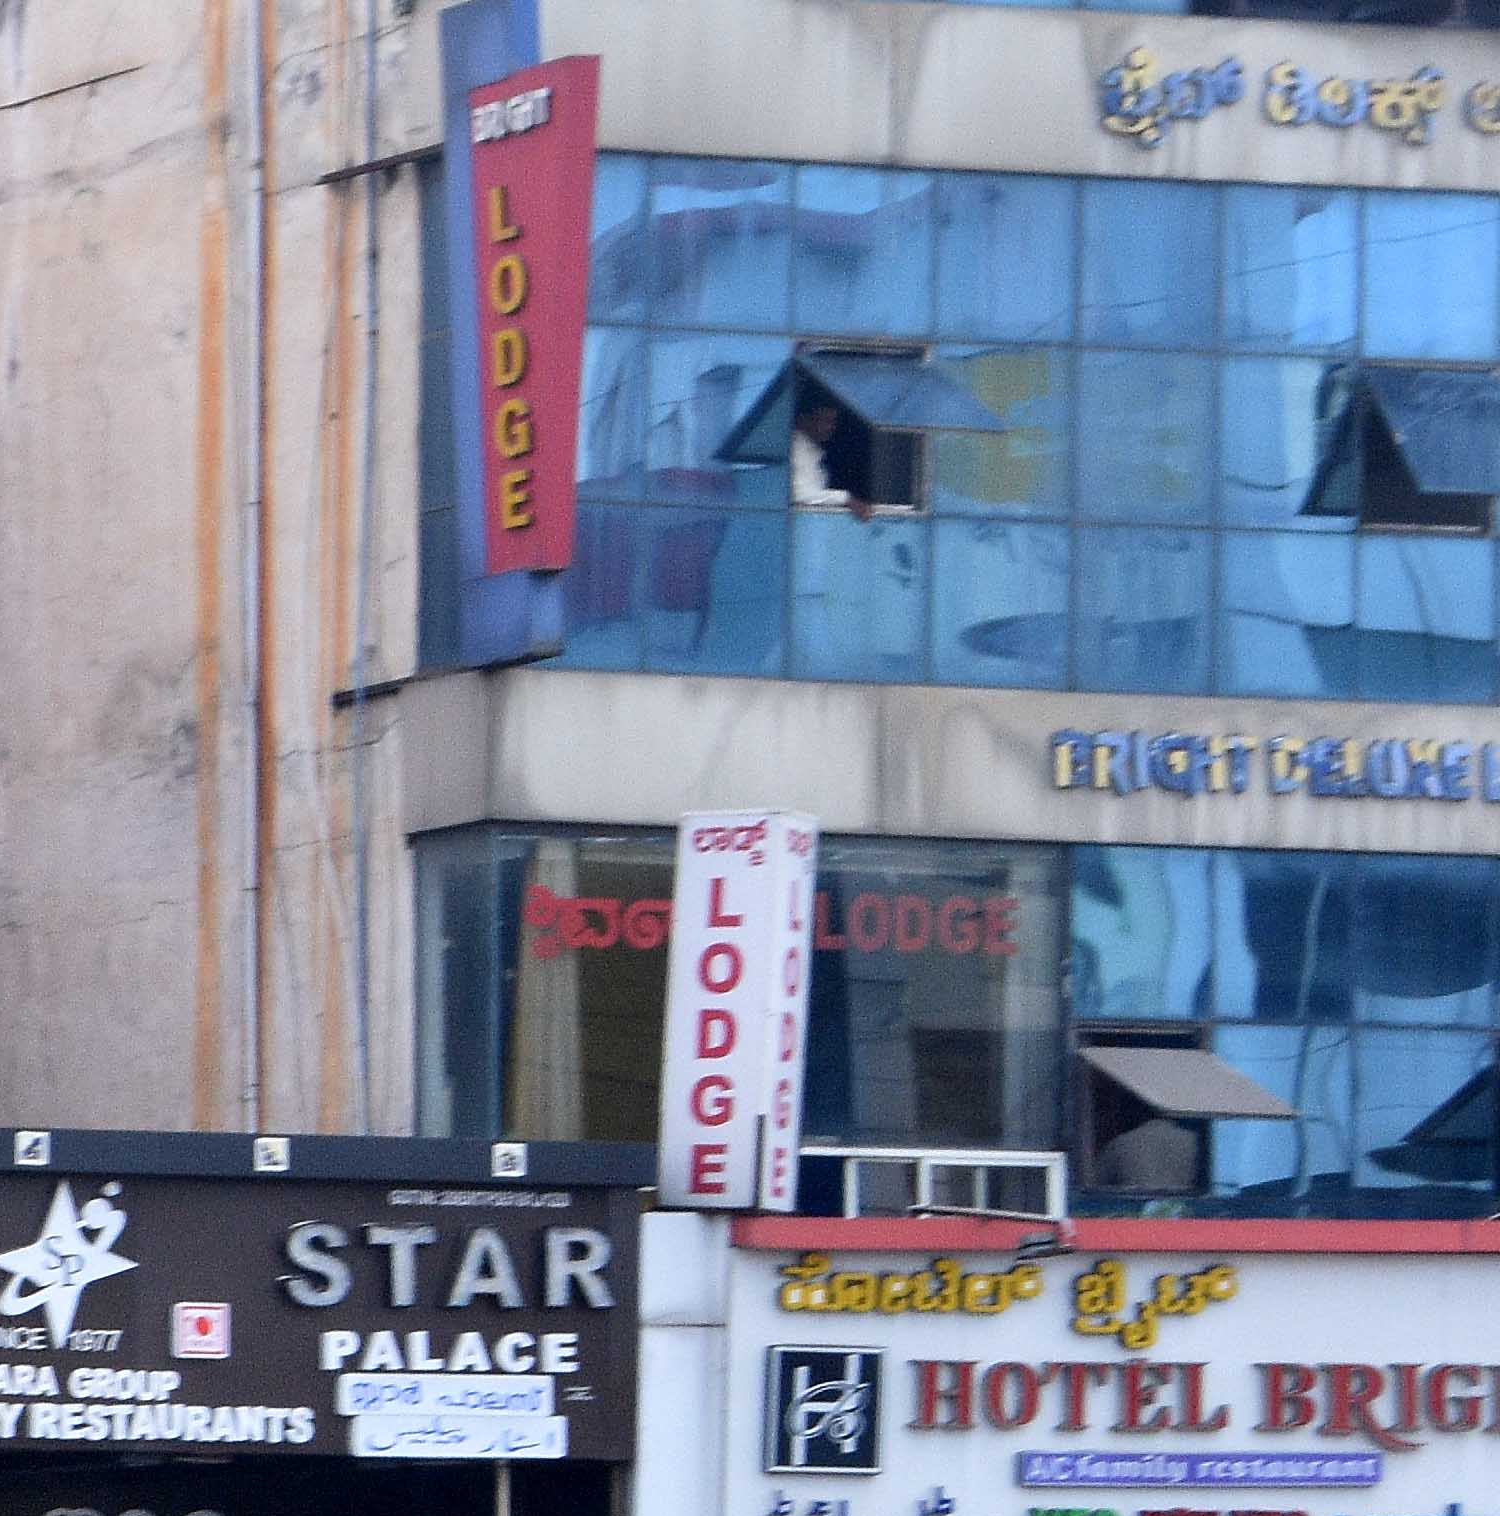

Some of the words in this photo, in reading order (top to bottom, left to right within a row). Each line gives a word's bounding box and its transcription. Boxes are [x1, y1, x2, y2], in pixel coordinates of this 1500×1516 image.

[488, 185, 536, 531] LODGE
[1050, 727, 1258, 797] BRIGHT
[1267, 733, 1474, 800] DELUXE
[812, 893, 1021, 958] LODGE
[688, 877, 746, 1195] LODGE
[280, 1219, 618, 1310] STAR
[67, 1328, 124, 1353] 1977
[318, 1330, 581, 1373] PALACE
[68, 1367, 182, 1403] GROUP
[904, 1357, 1233, 1436] HOTEL
[1251, 1358, 1500, 1452] BRIG
[28, 1403, 316, 1446] RESTAURANTS
[1076, 1453, 1191, 1485] family
[1200, 1458, 1376, 1482] restaurant
